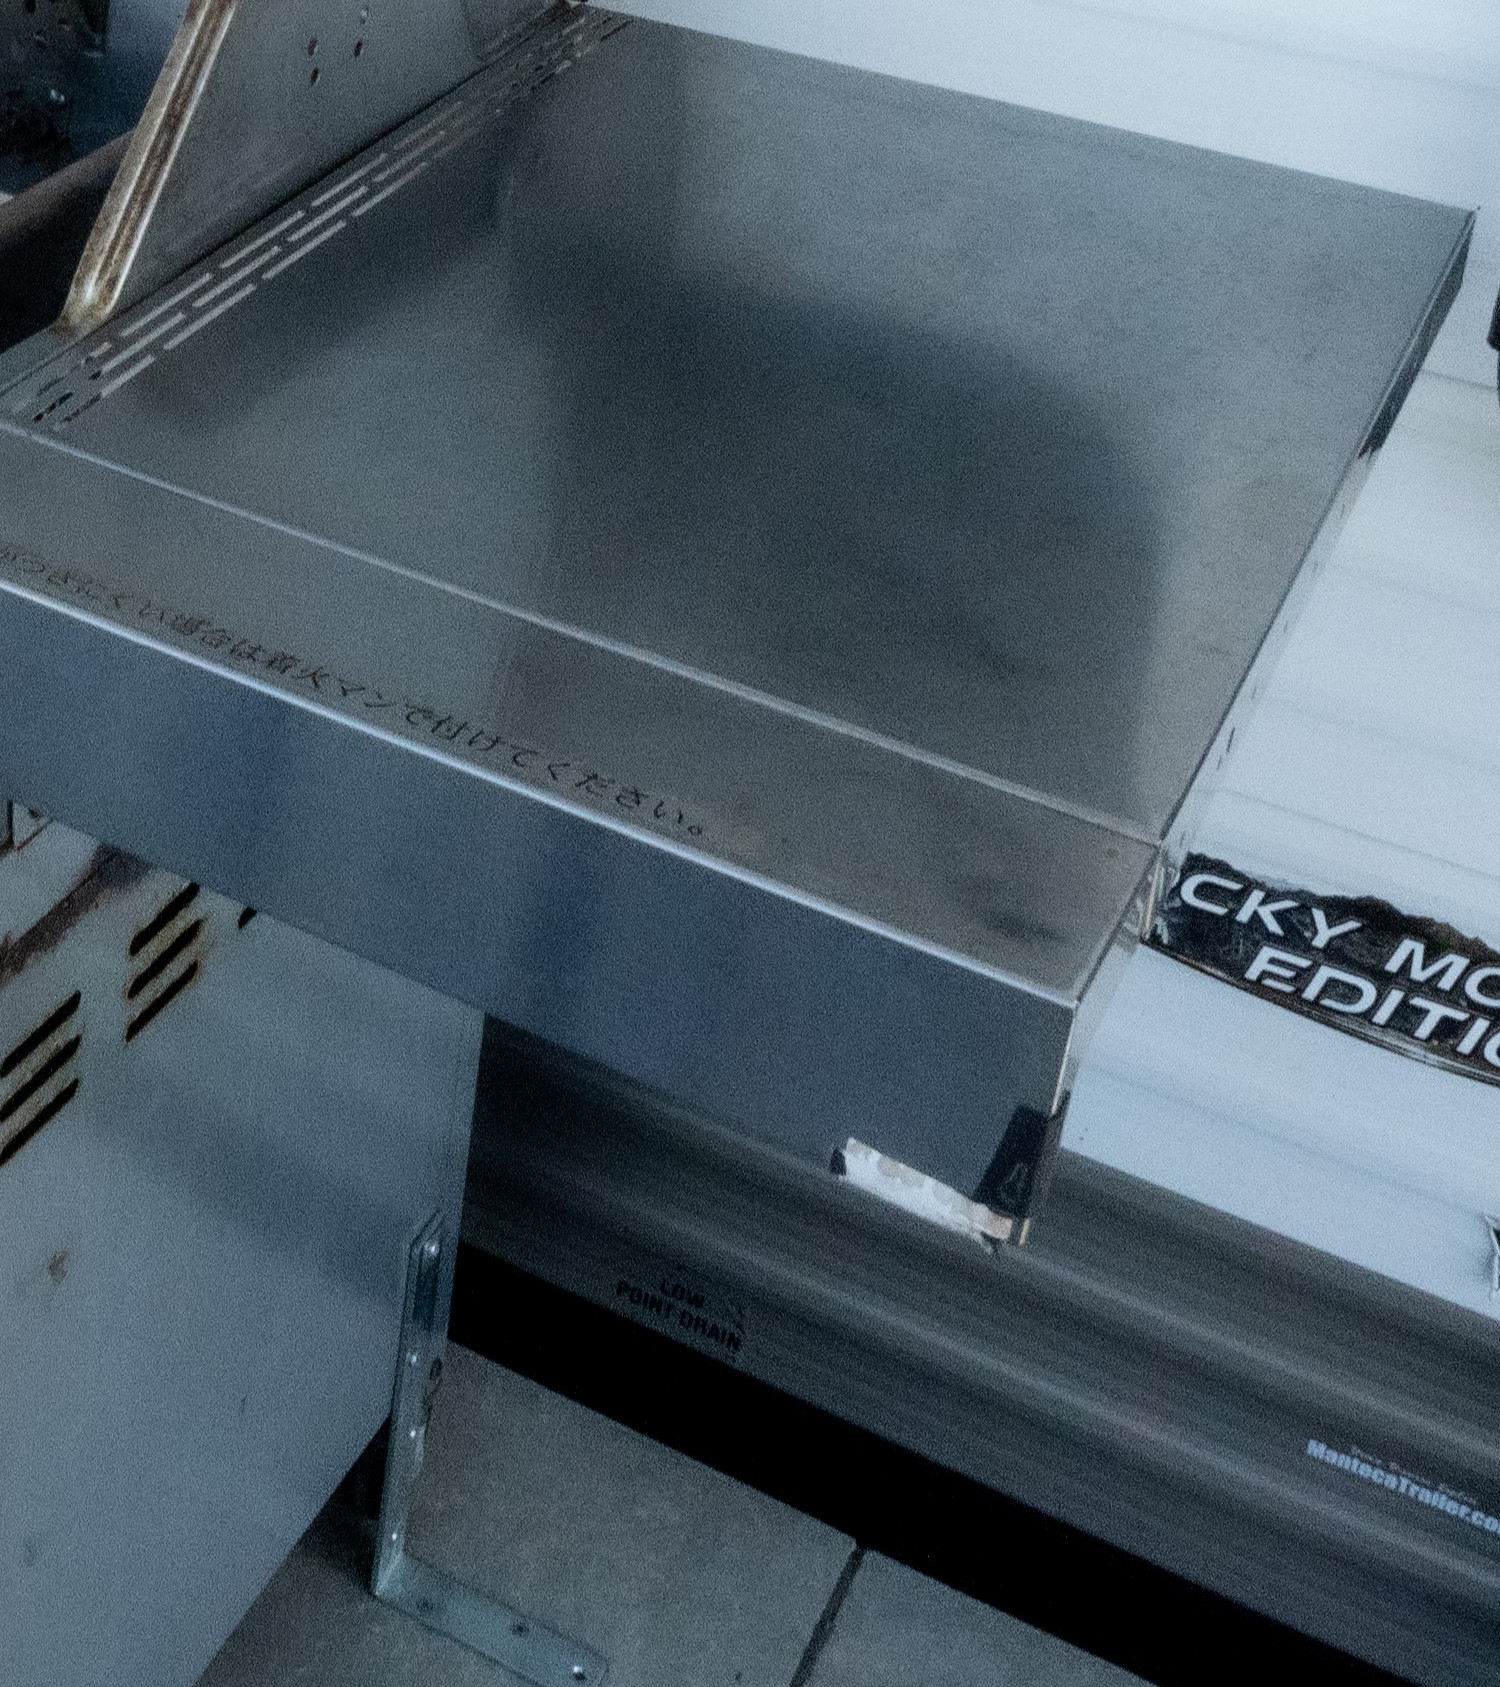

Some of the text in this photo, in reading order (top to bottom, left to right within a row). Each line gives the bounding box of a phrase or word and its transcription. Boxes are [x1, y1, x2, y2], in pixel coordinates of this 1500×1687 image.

[1180, 872, 1363, 950] CKY
[615, 1280, 742, 1351] POINT DRAIN
[659, 1277, 705, 1309] LOW
